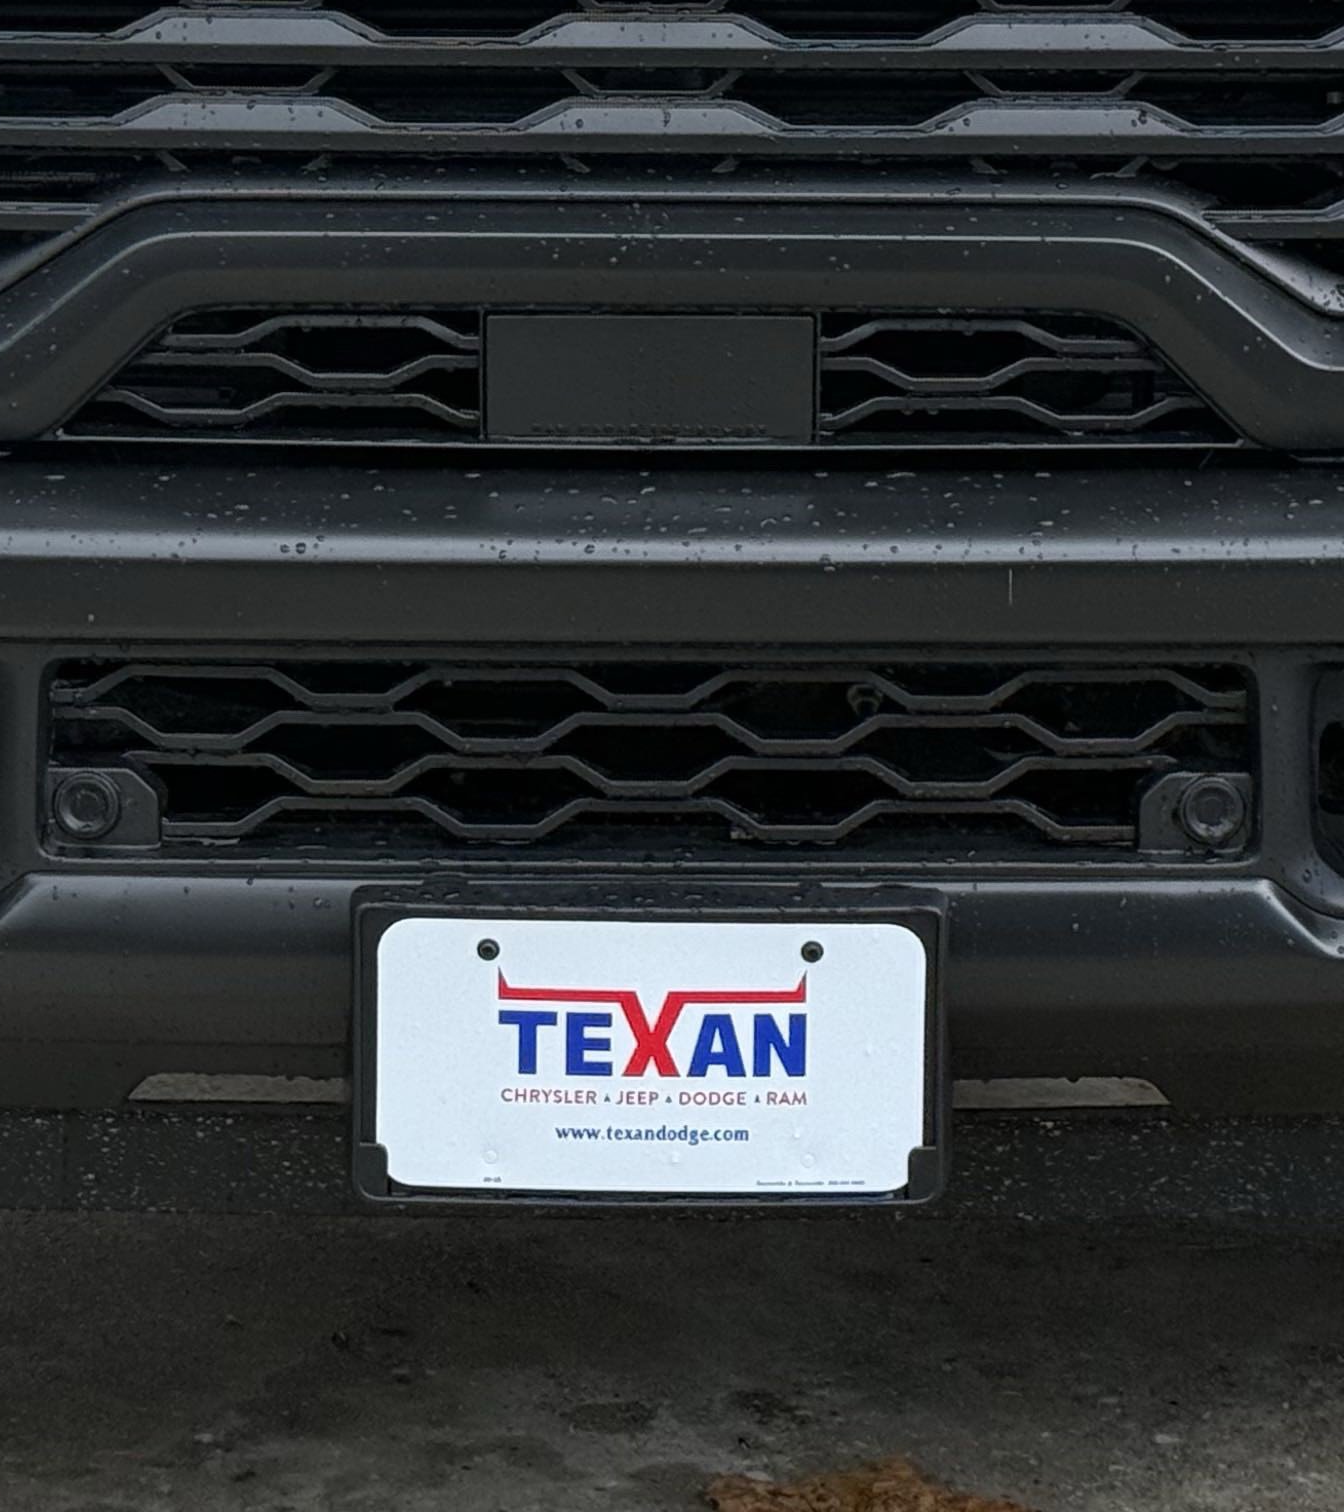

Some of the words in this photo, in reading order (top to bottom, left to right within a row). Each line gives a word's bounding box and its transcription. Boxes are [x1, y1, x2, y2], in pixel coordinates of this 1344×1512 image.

[498, 990, 807, 1078] TEXAN
[501, 1088, 597, 1105] CHRYSLER
[615, 1090, 659, 1106] JEEP
[678, 1091, 747, 1106] DODGE
[766, 1091, 808, 1106] RAM
[556, 1125, 750, 1145] www.texandodge.com
